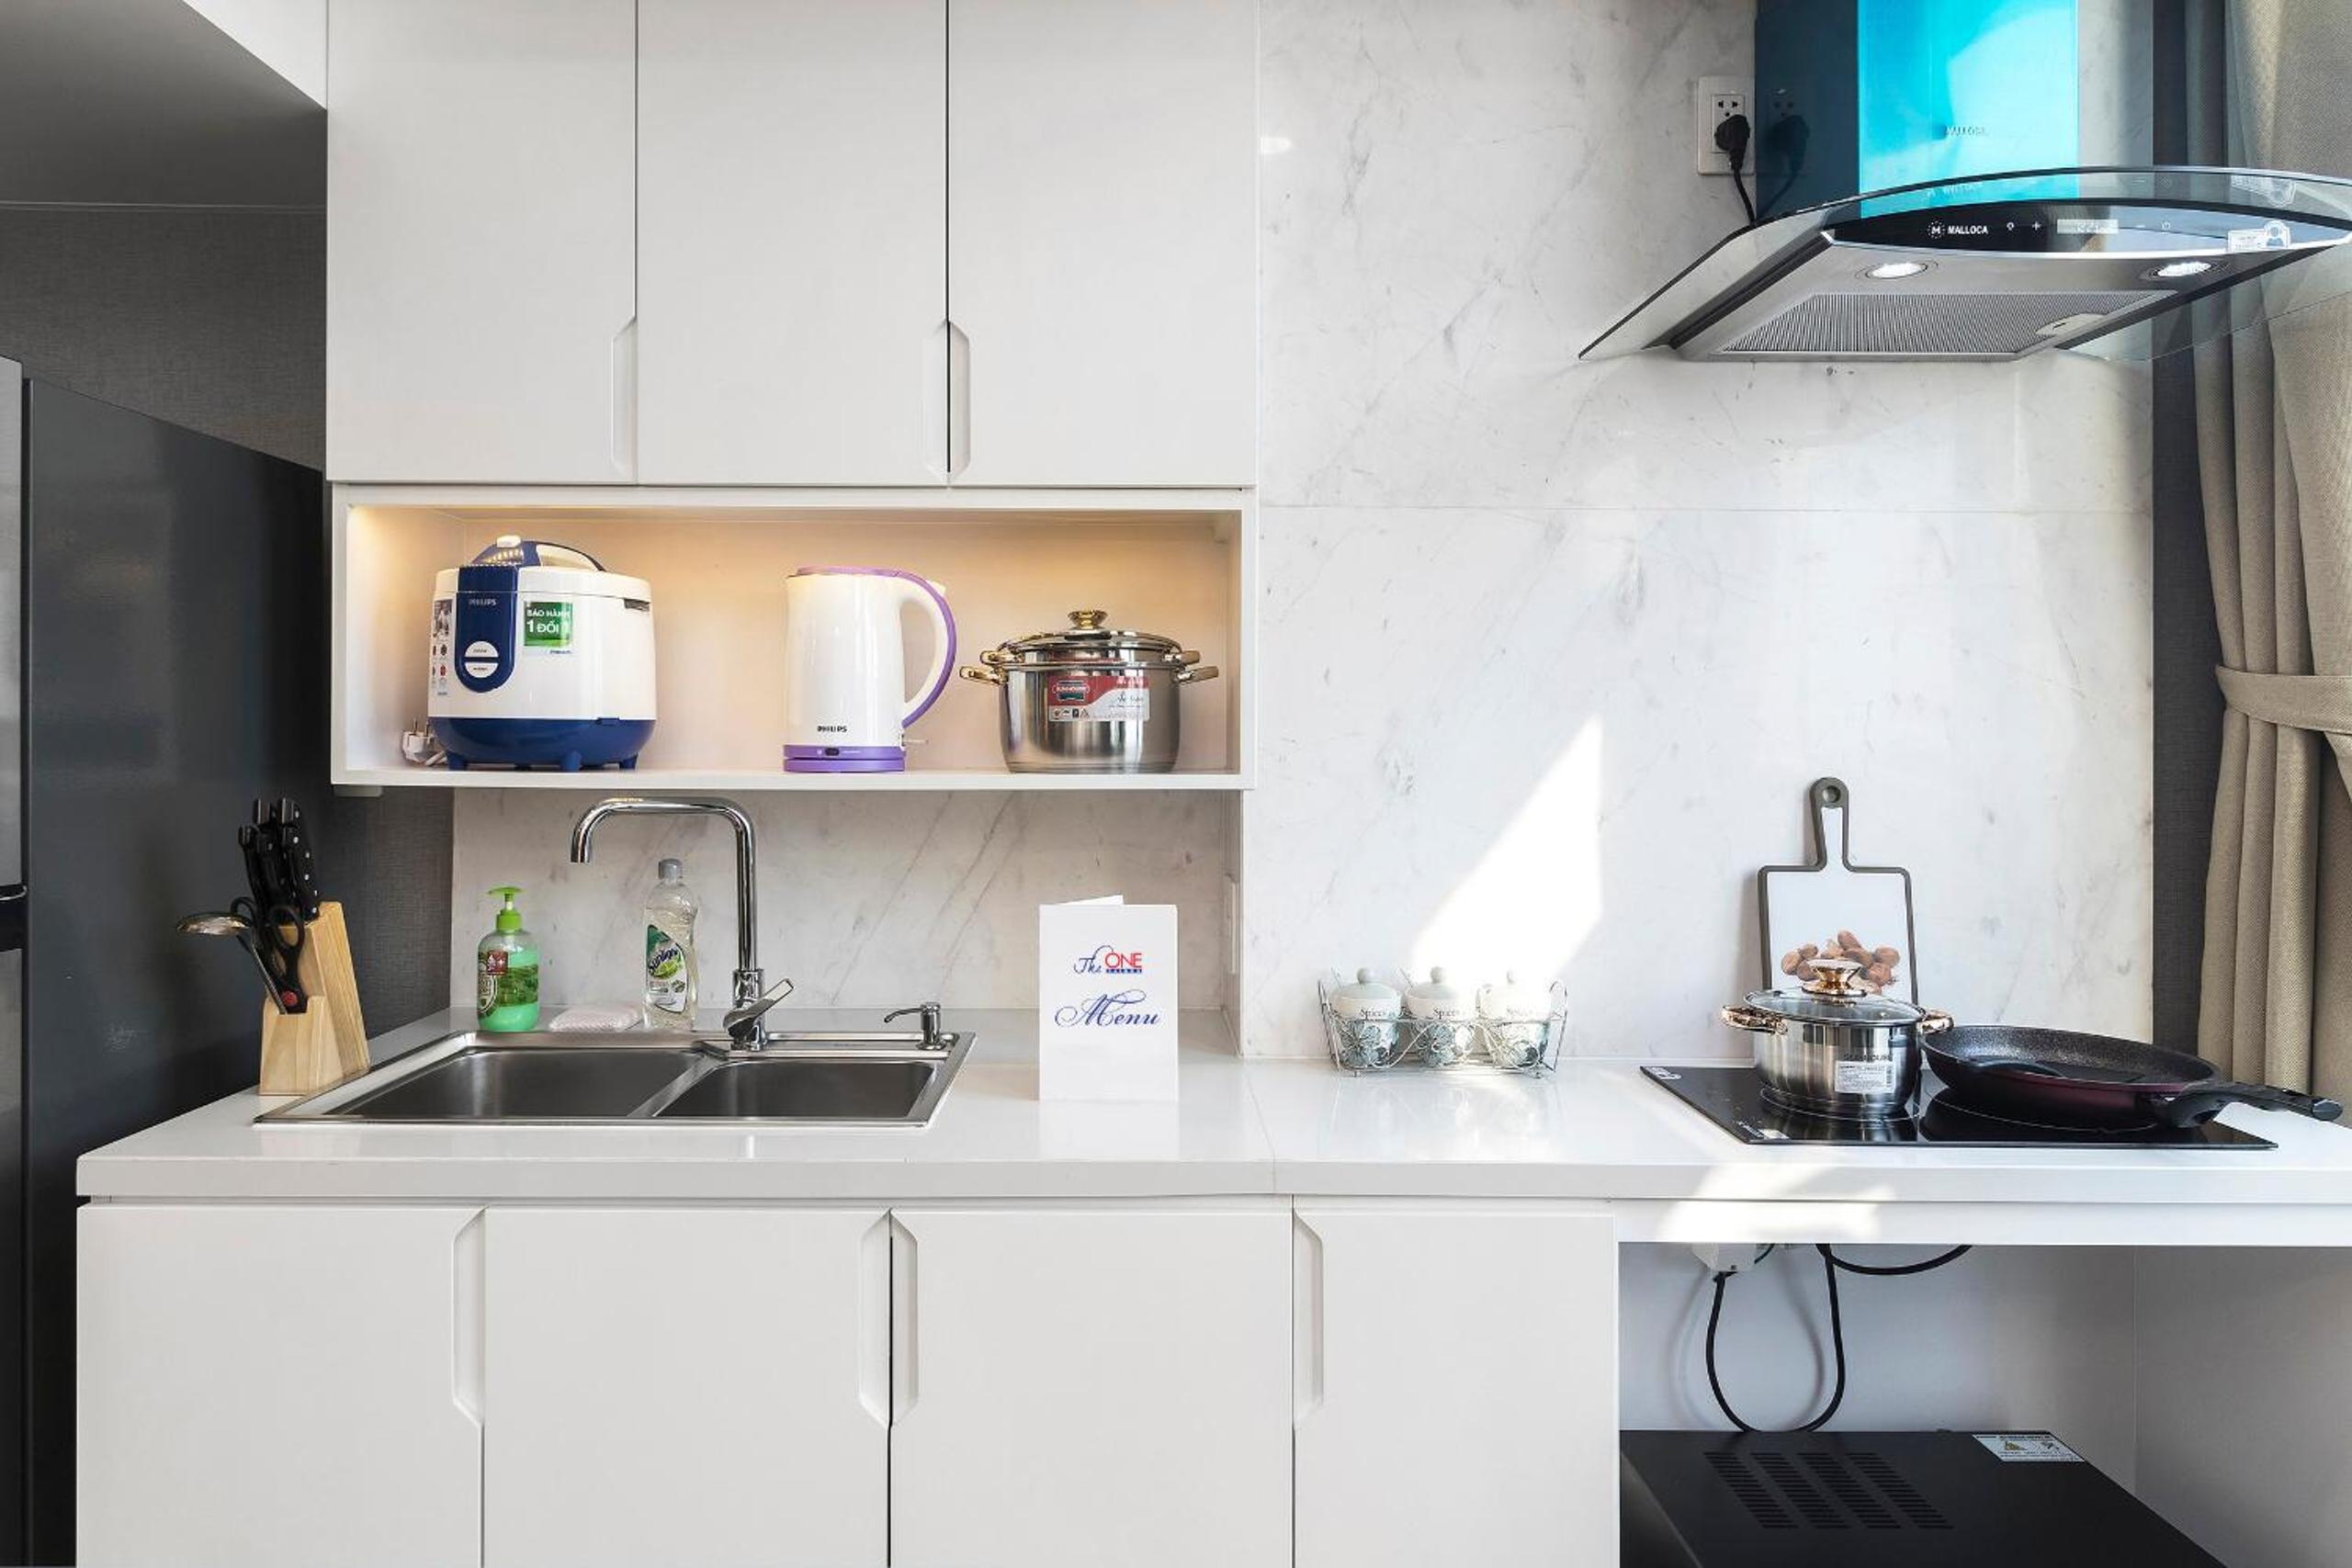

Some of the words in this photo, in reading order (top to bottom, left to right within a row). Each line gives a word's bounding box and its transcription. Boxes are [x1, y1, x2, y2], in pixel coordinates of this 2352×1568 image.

[1948, 225, 1989, 234] MALLOCA
[526, 619, 535, 633] 1
[817, 725, 848, 733] PHILIPS
[1073, 944, 1114, 975] The
[1104, 953, 1143, 969] ONE
[1055, 988, 1160, 1027] Menu
